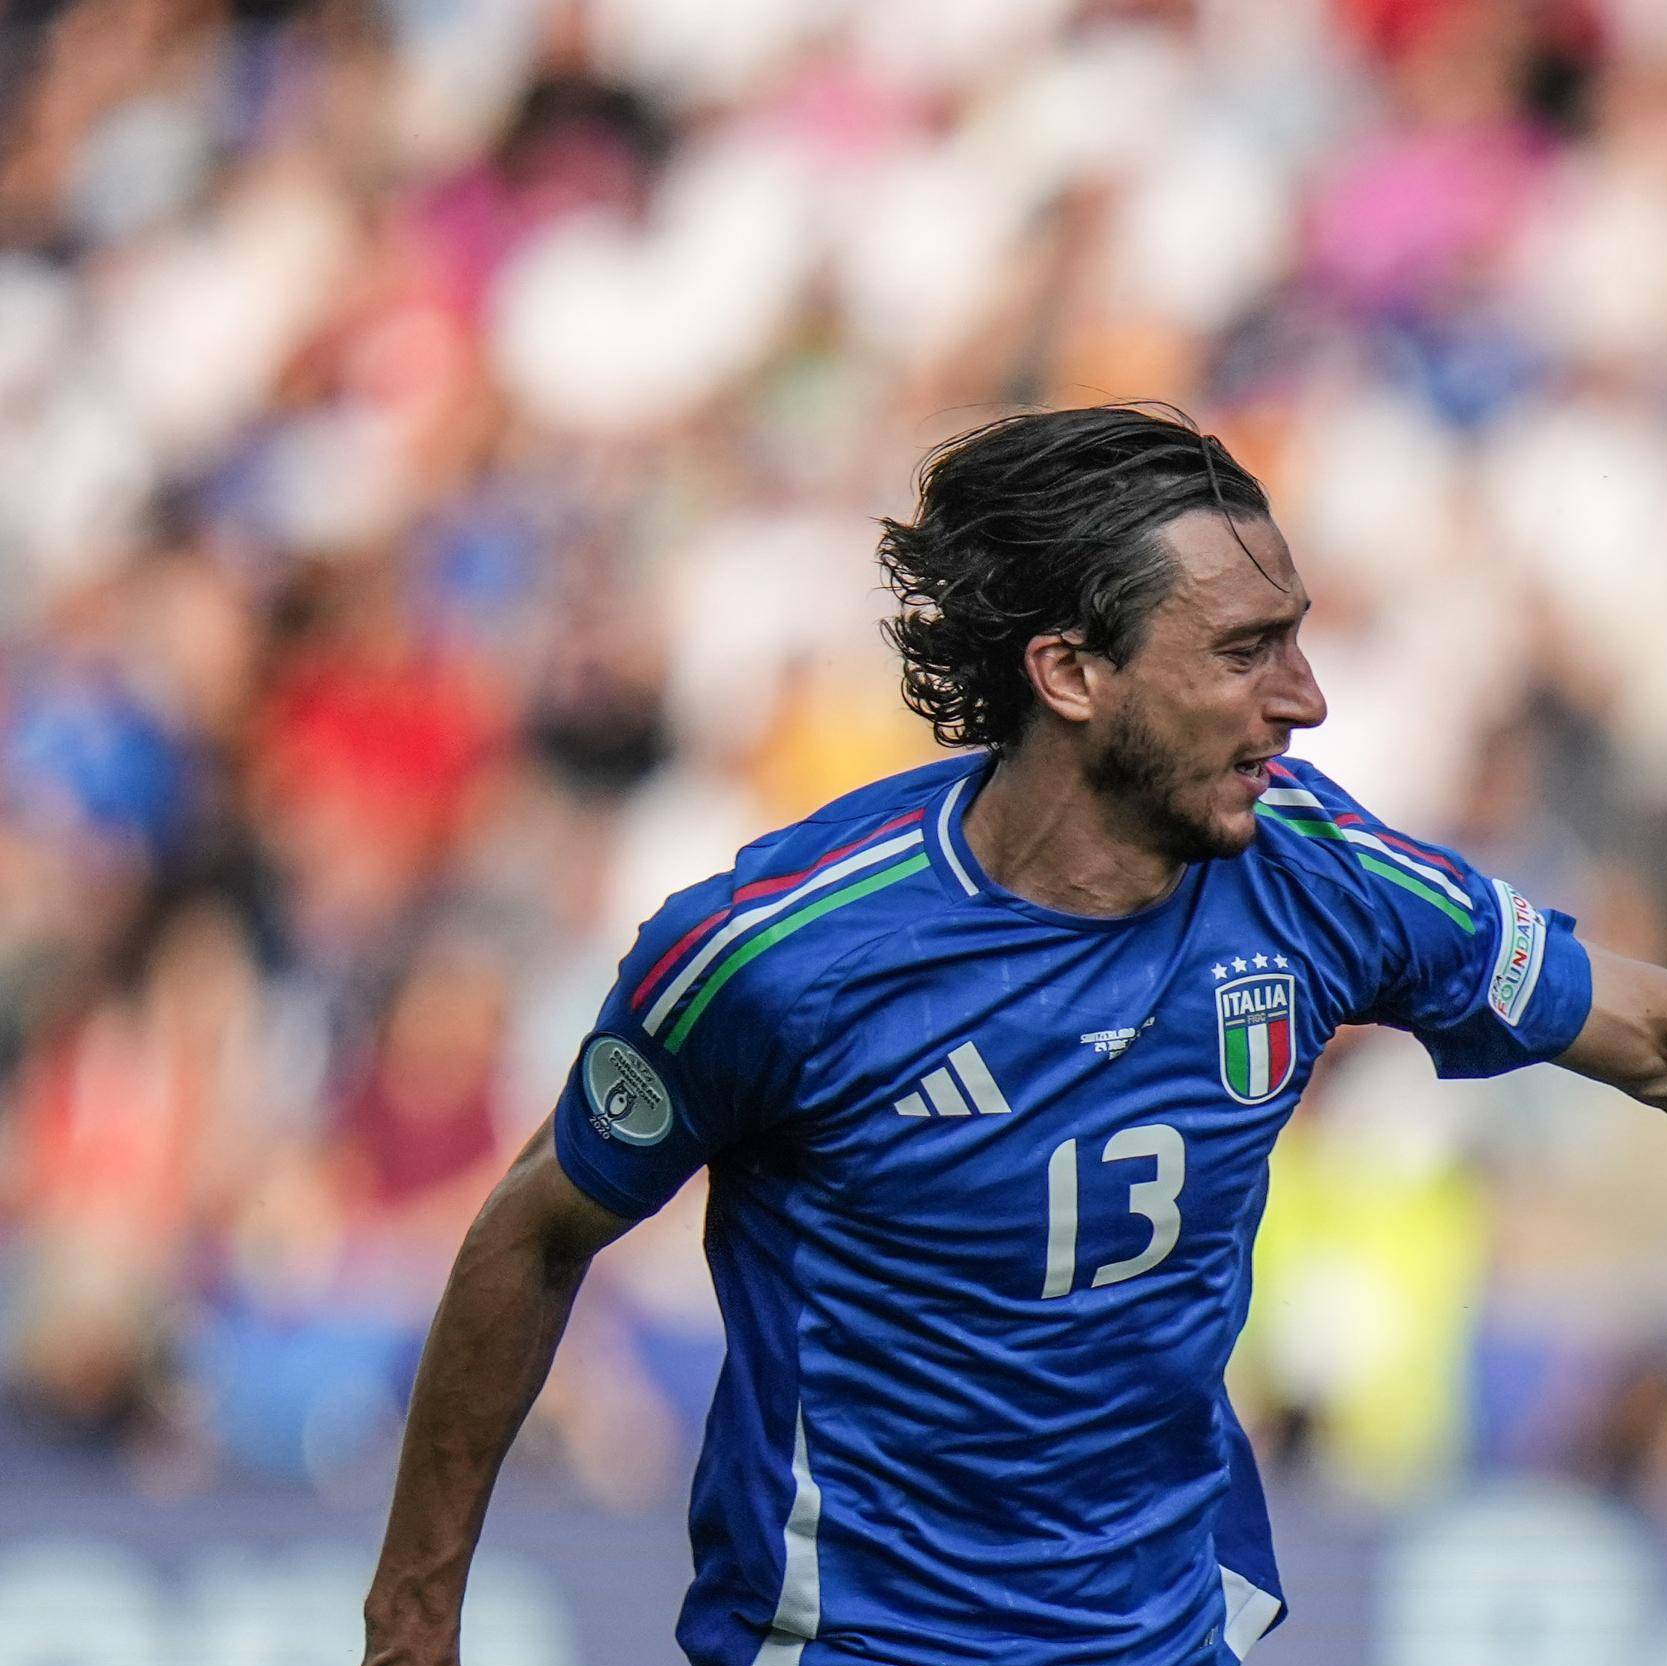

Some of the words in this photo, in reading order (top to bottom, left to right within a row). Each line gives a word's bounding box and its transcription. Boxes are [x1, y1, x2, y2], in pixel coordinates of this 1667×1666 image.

[1497, 884, 1535, 1018] FOUNDATIO
[1222, 983, 1288, 1018] ITALIA
[589, 1114, 610, 1140] 2020
[1041, 1124, 1185, 1299] 13
